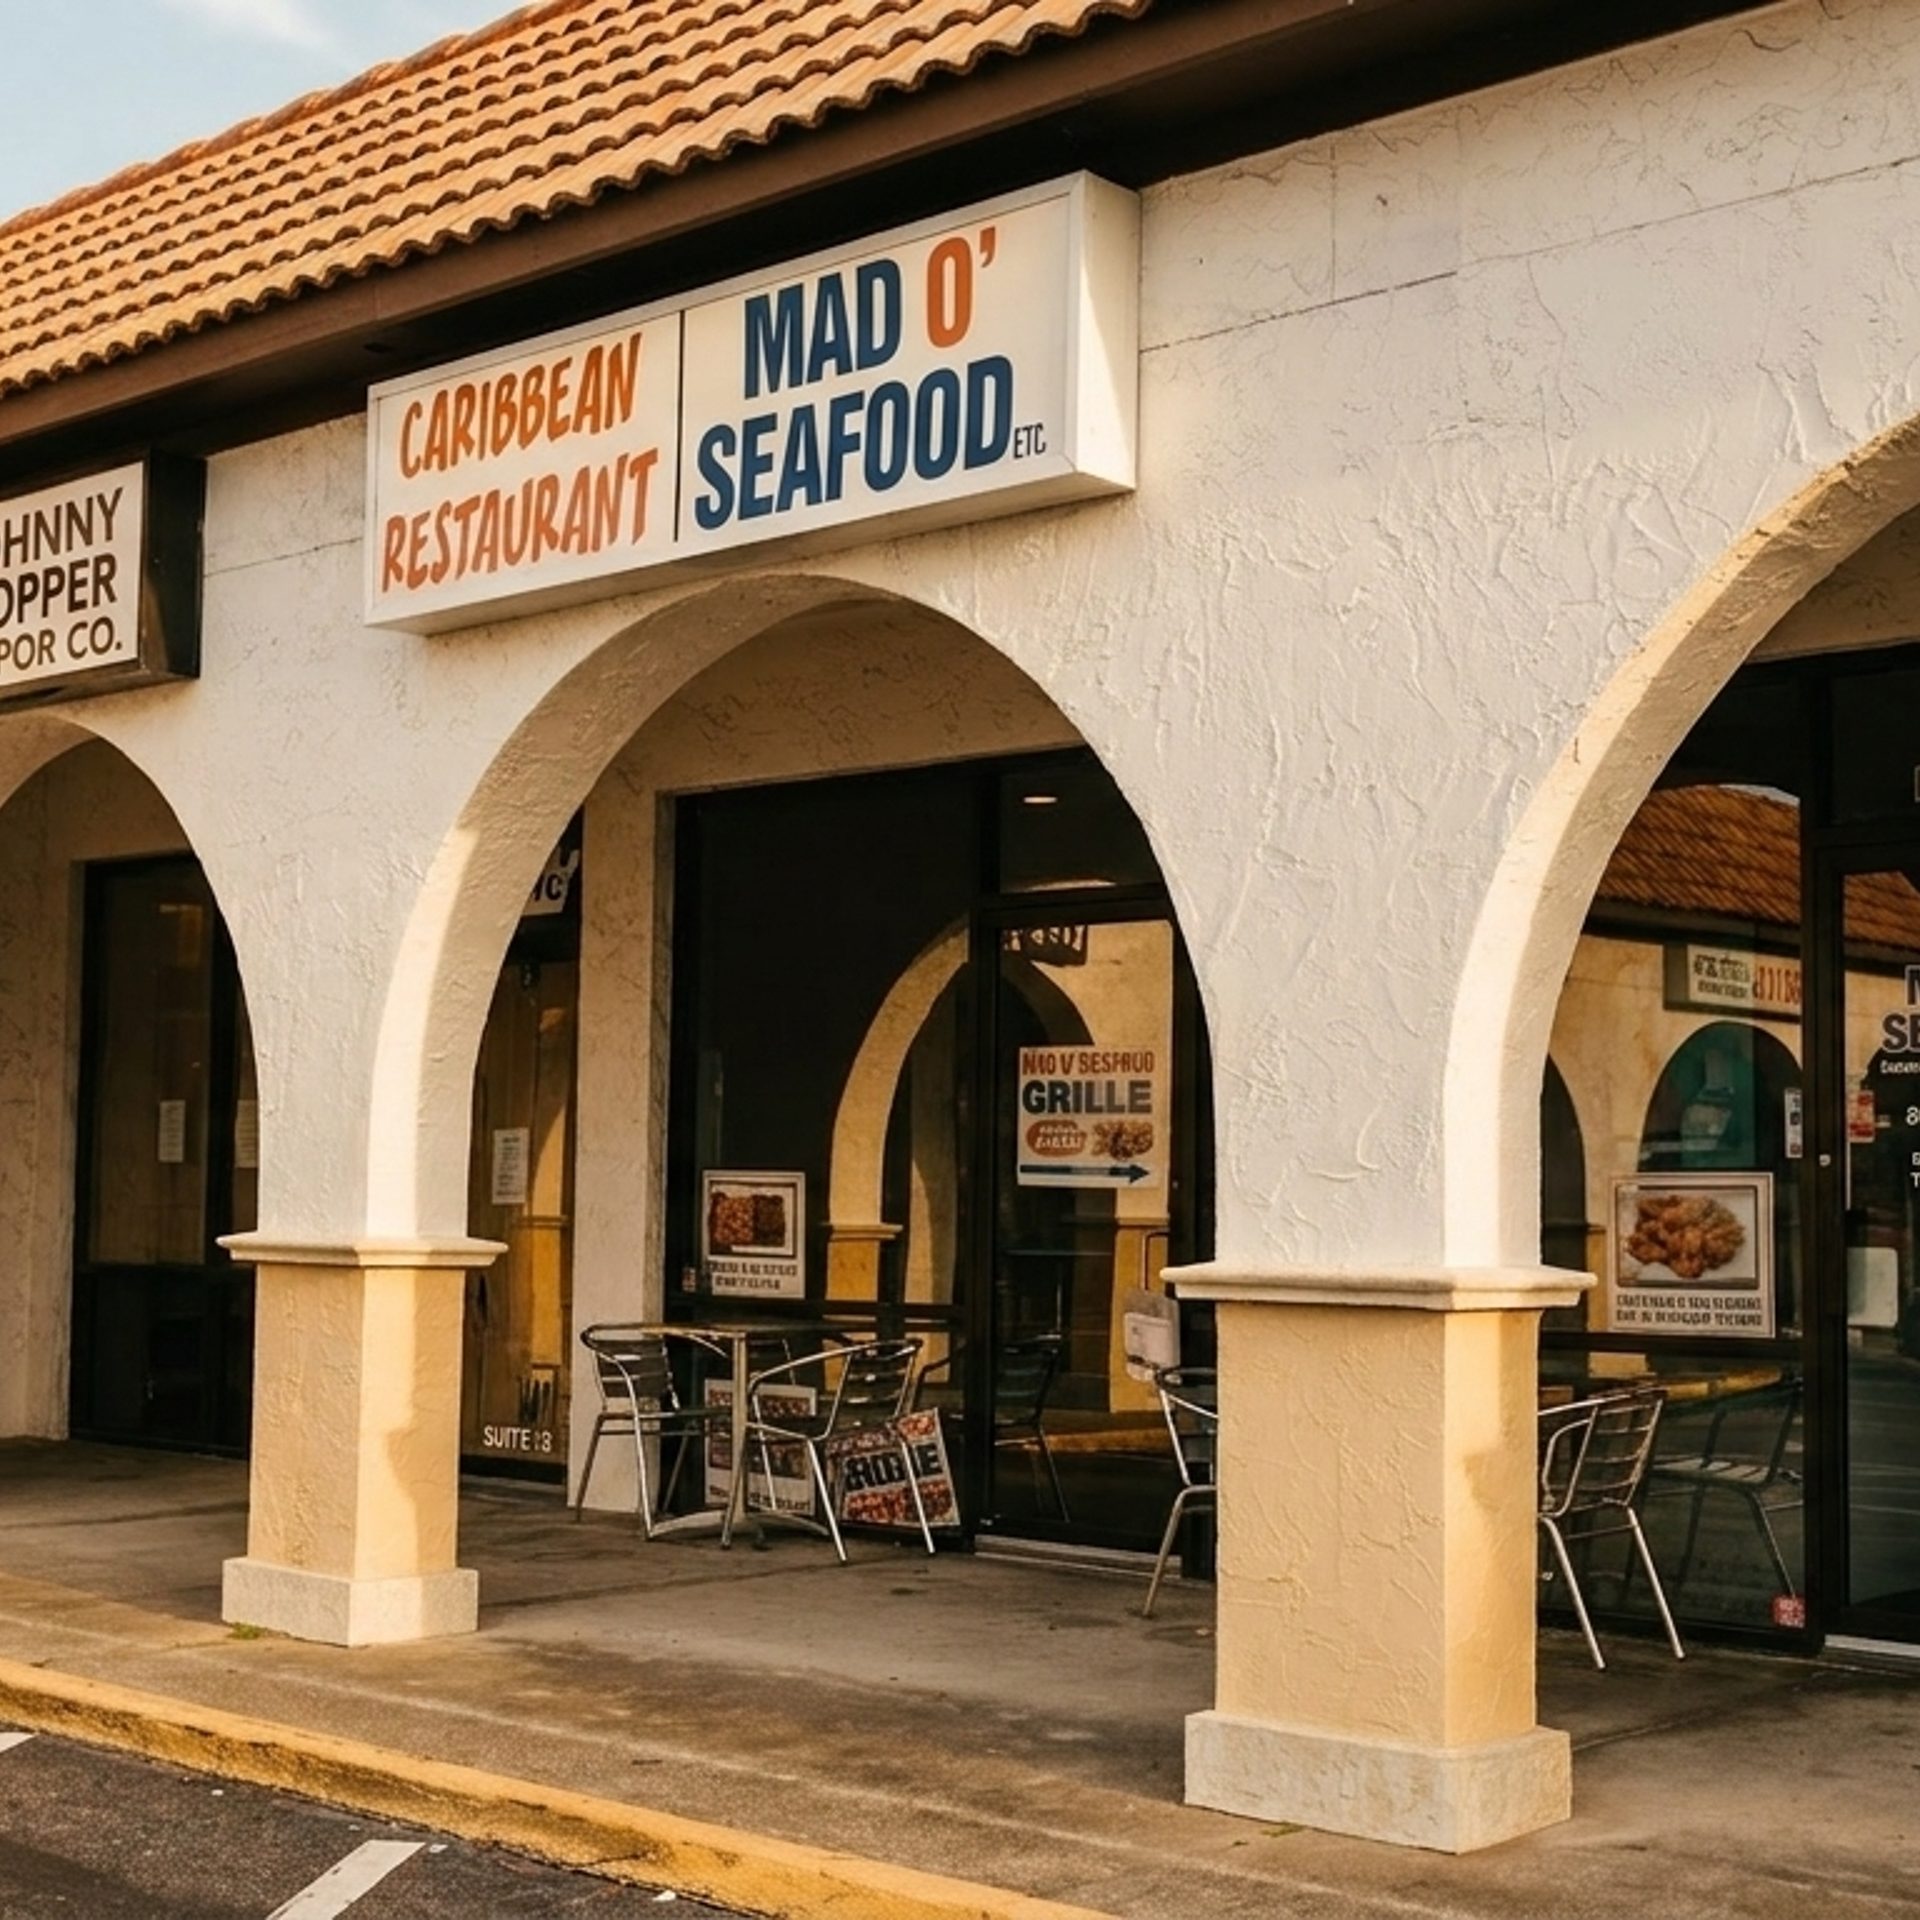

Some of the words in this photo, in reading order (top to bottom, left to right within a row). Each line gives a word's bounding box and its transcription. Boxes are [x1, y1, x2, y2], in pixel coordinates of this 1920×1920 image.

[743, 257, 902, 400] MAD
[925, 225, 997, 349] O'
[400, 333, 643, 479] CARIBBEAN
[695, 354, 1013, 531] SEAFOOD
[1014, 422, 1046, 459] ETC
[0, 486, 123, 567] HNNY
[381, 446, 659, 593] RESTAURANT
[67, 616, 123, 659] CO.
[1022, 1079, 1153, 1115] GRILLE
[483, 1425, 532, 1451] SUITE
